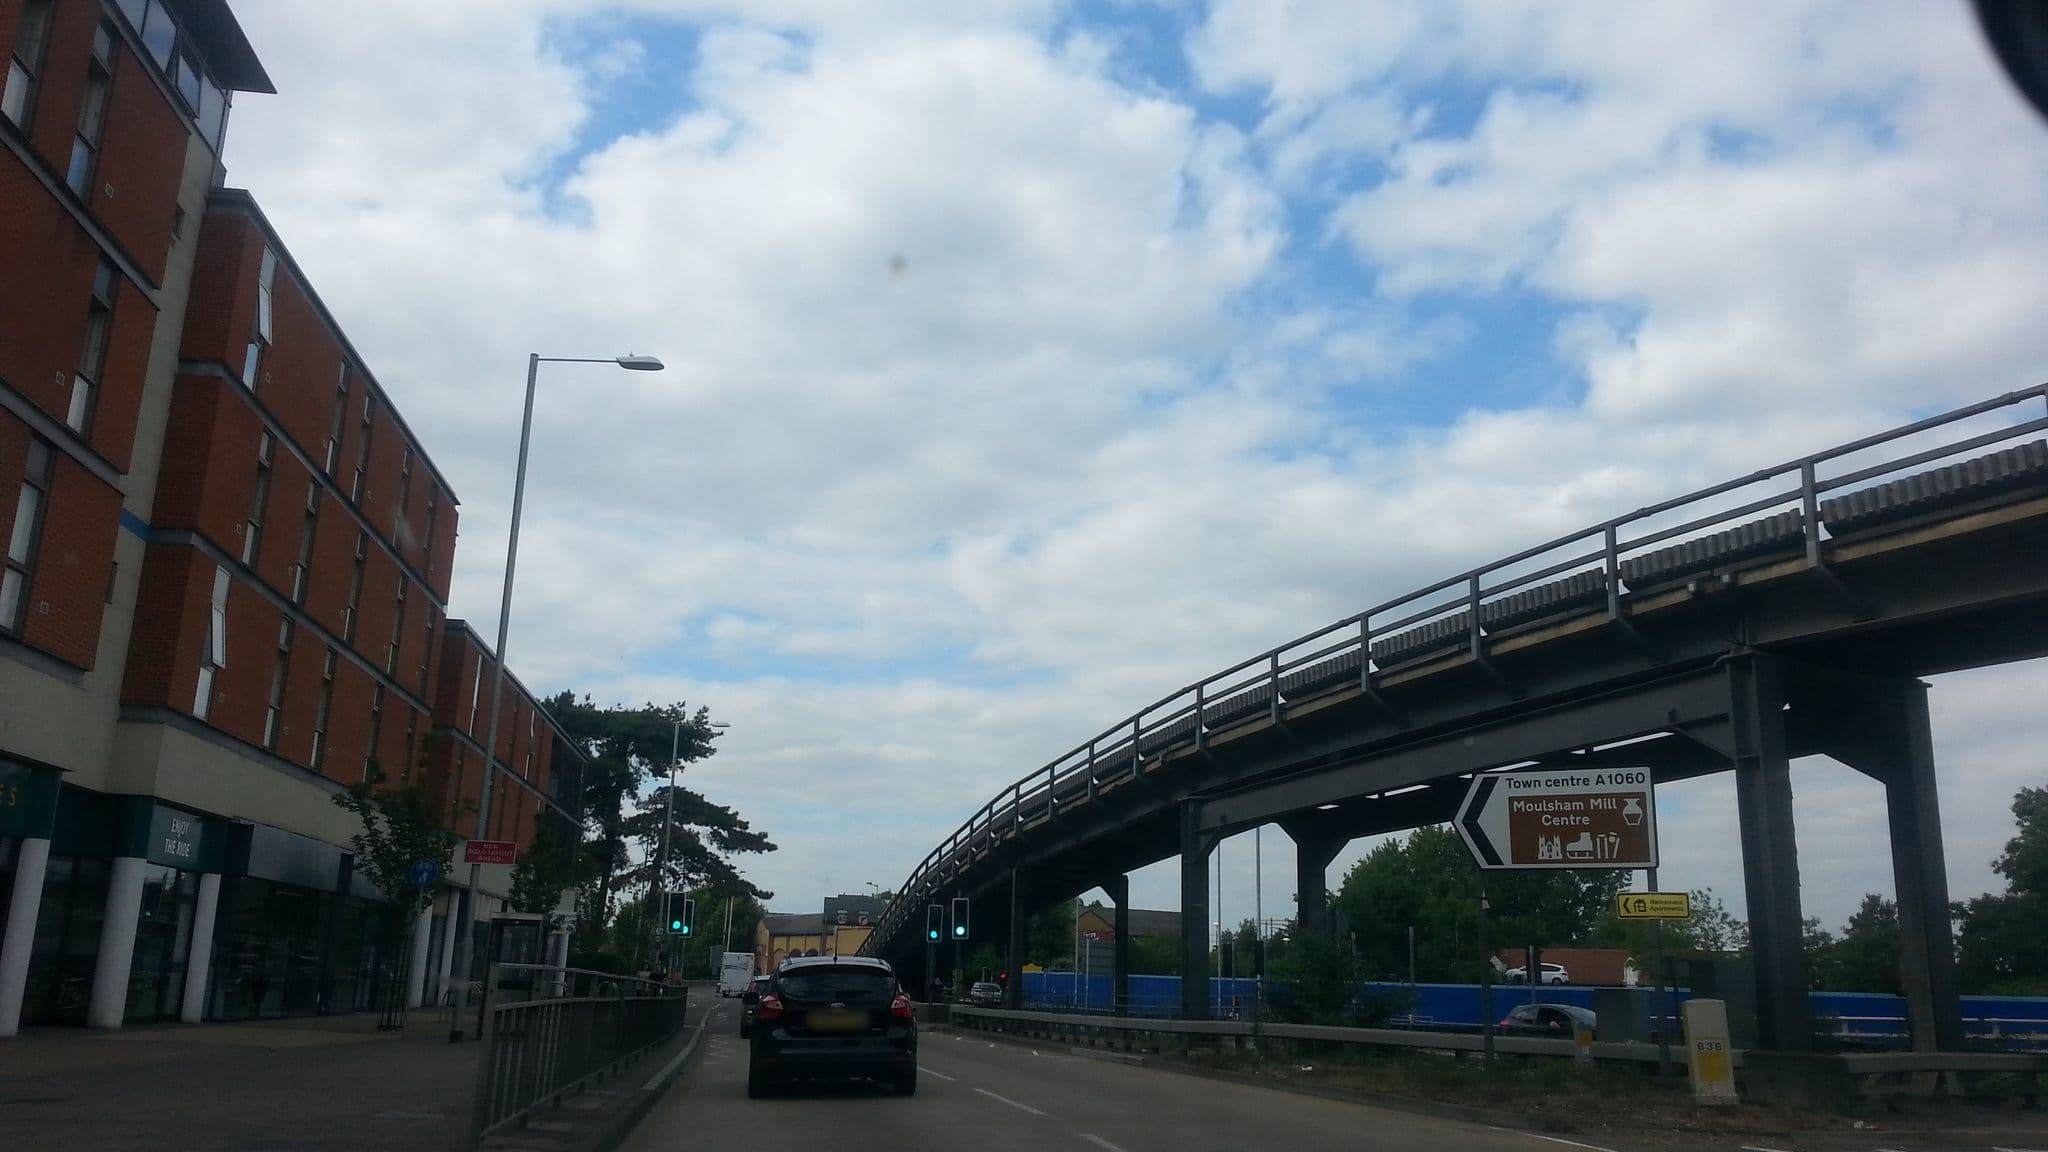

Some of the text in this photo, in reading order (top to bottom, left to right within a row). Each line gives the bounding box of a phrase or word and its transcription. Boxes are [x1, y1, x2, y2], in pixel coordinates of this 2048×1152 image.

[1506, 772, 1646, 789] Town centre A1060
[1513, 798, 1618, 812] Moulsham Mill
[1541, 814, 1591, 826] Centre
